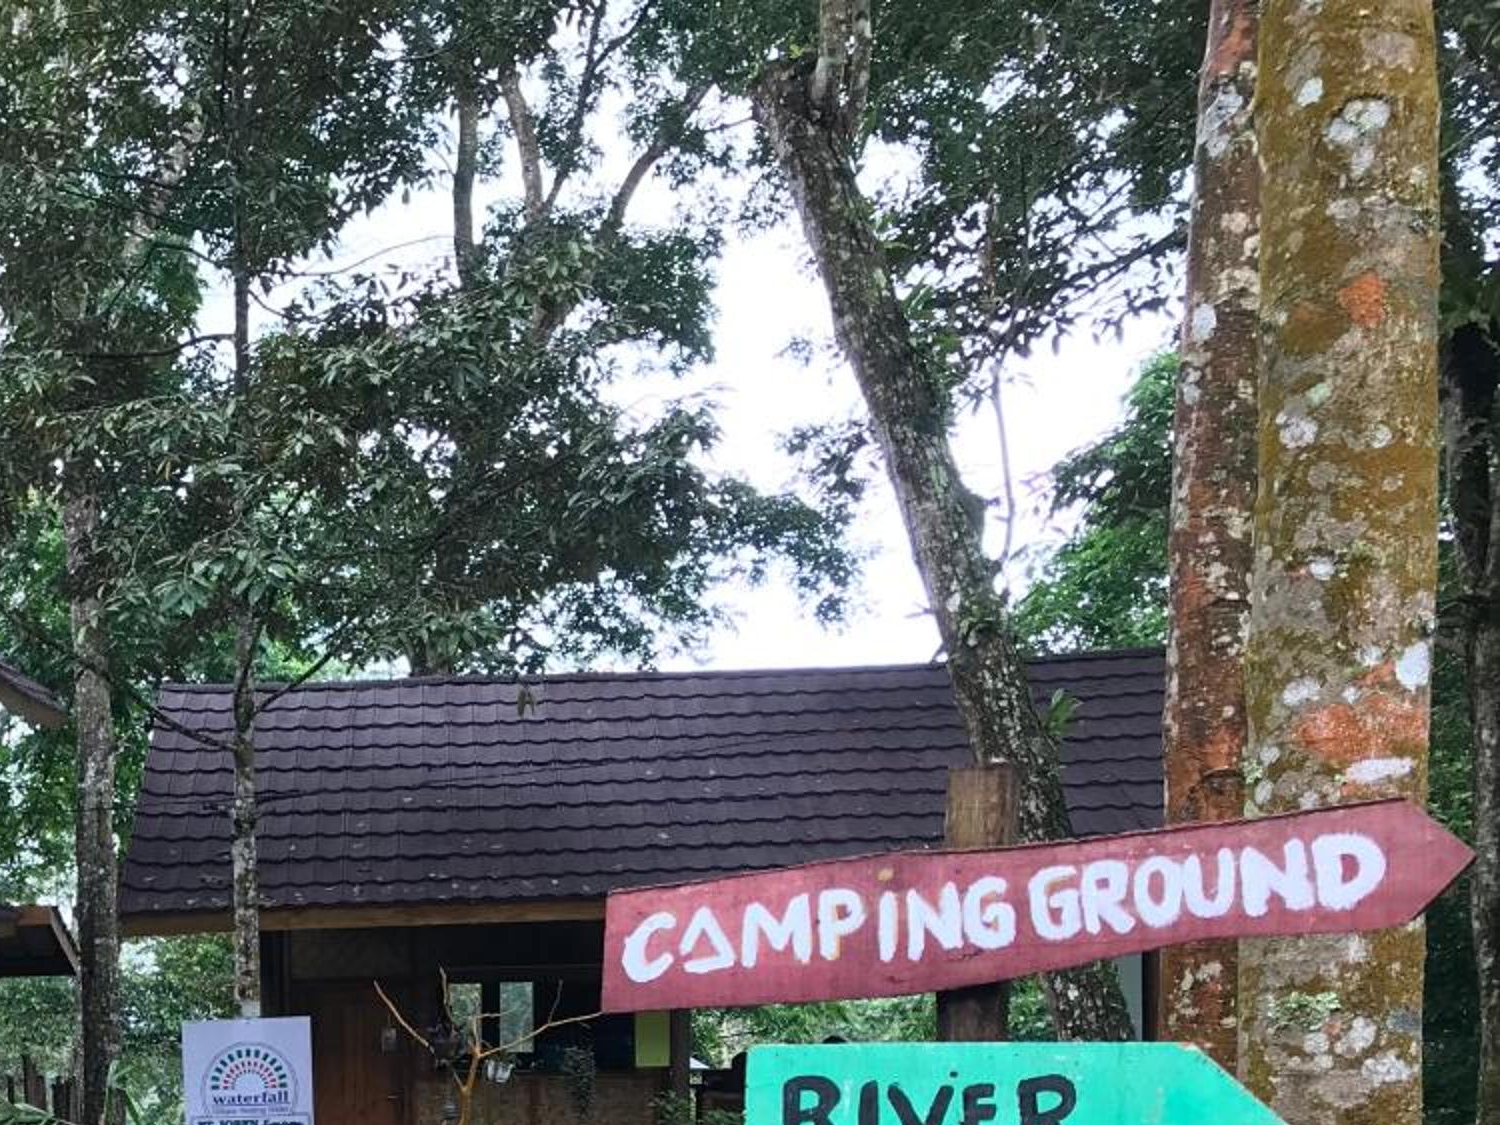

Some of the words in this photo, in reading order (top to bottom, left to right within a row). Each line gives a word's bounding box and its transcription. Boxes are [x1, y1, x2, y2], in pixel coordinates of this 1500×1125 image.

[621, 876, 1017, 983] CAMPING
[1029, 832, 1386, 940] GROUND
[213, 1090, 289, 1105] waterfall
